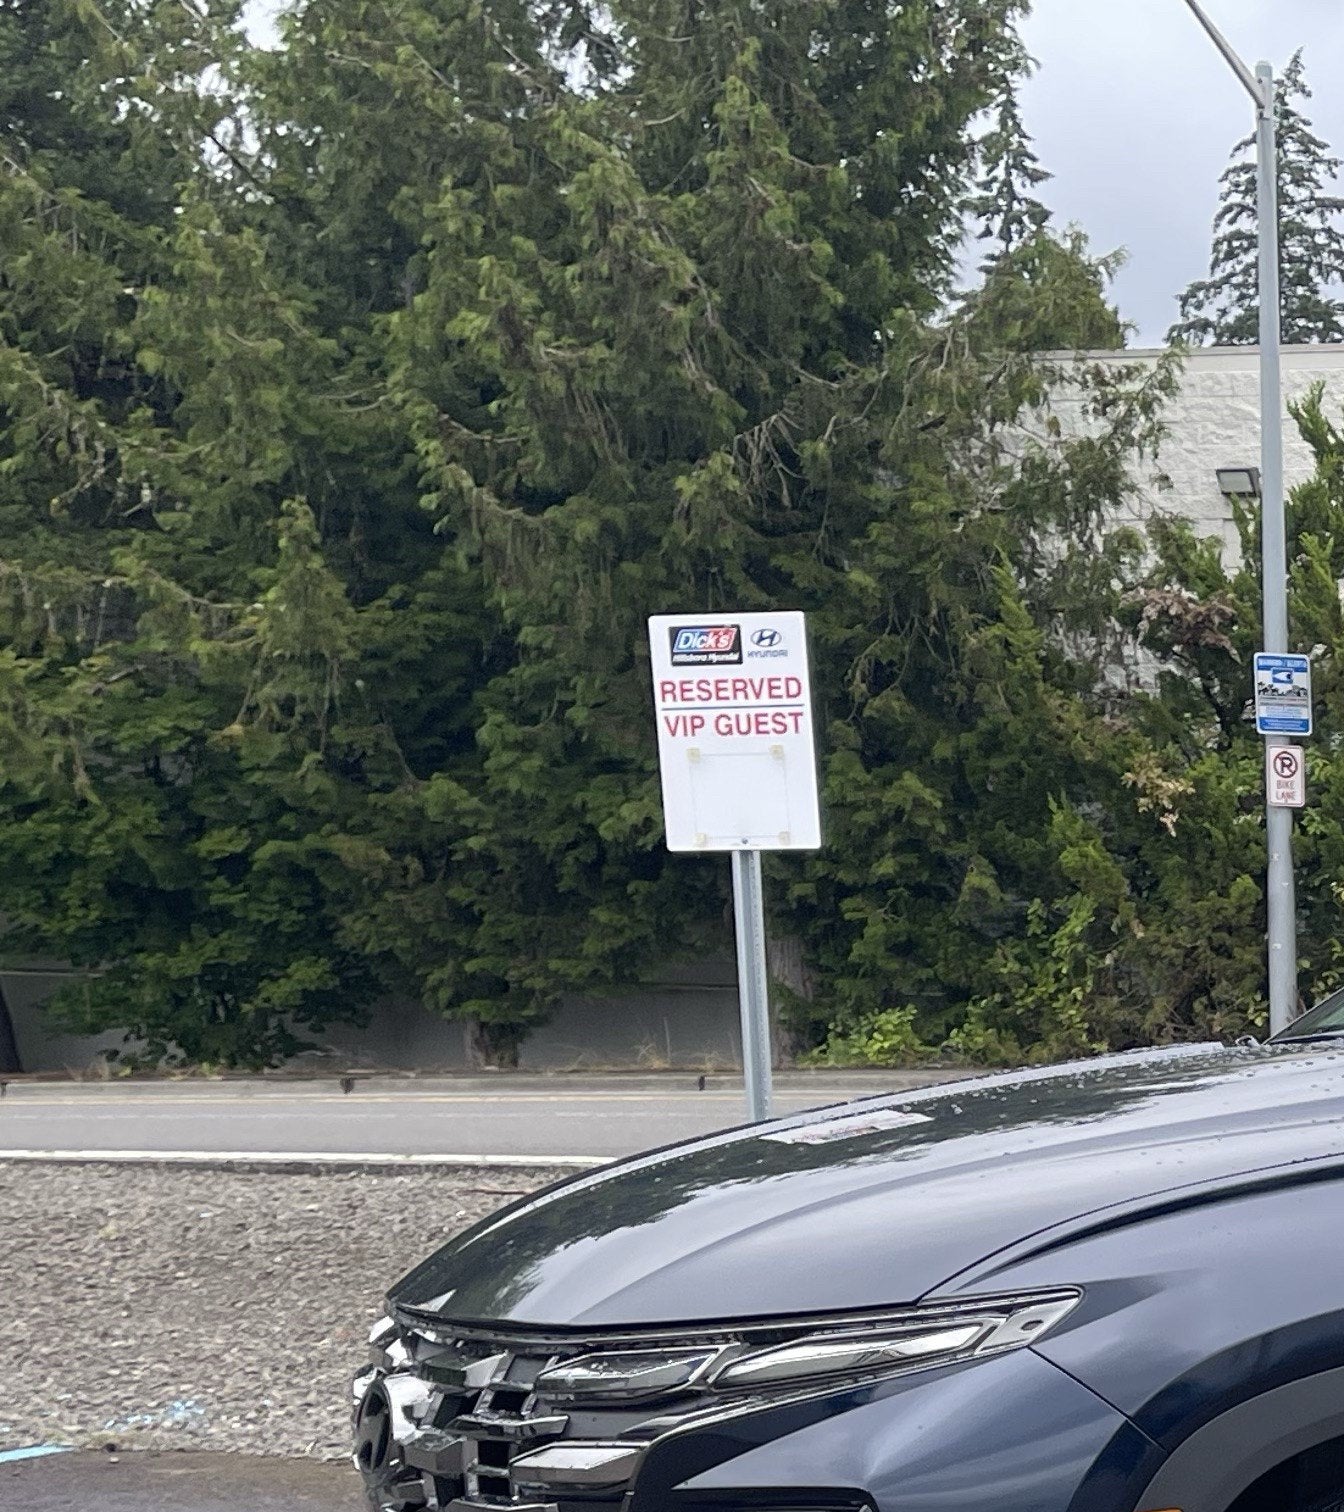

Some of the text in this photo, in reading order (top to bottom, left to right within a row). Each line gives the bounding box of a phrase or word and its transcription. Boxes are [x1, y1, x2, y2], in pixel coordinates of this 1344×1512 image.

[660, 677, 803, 703] RESERVED
[664, 711, 804, 738] VIP GUEST
